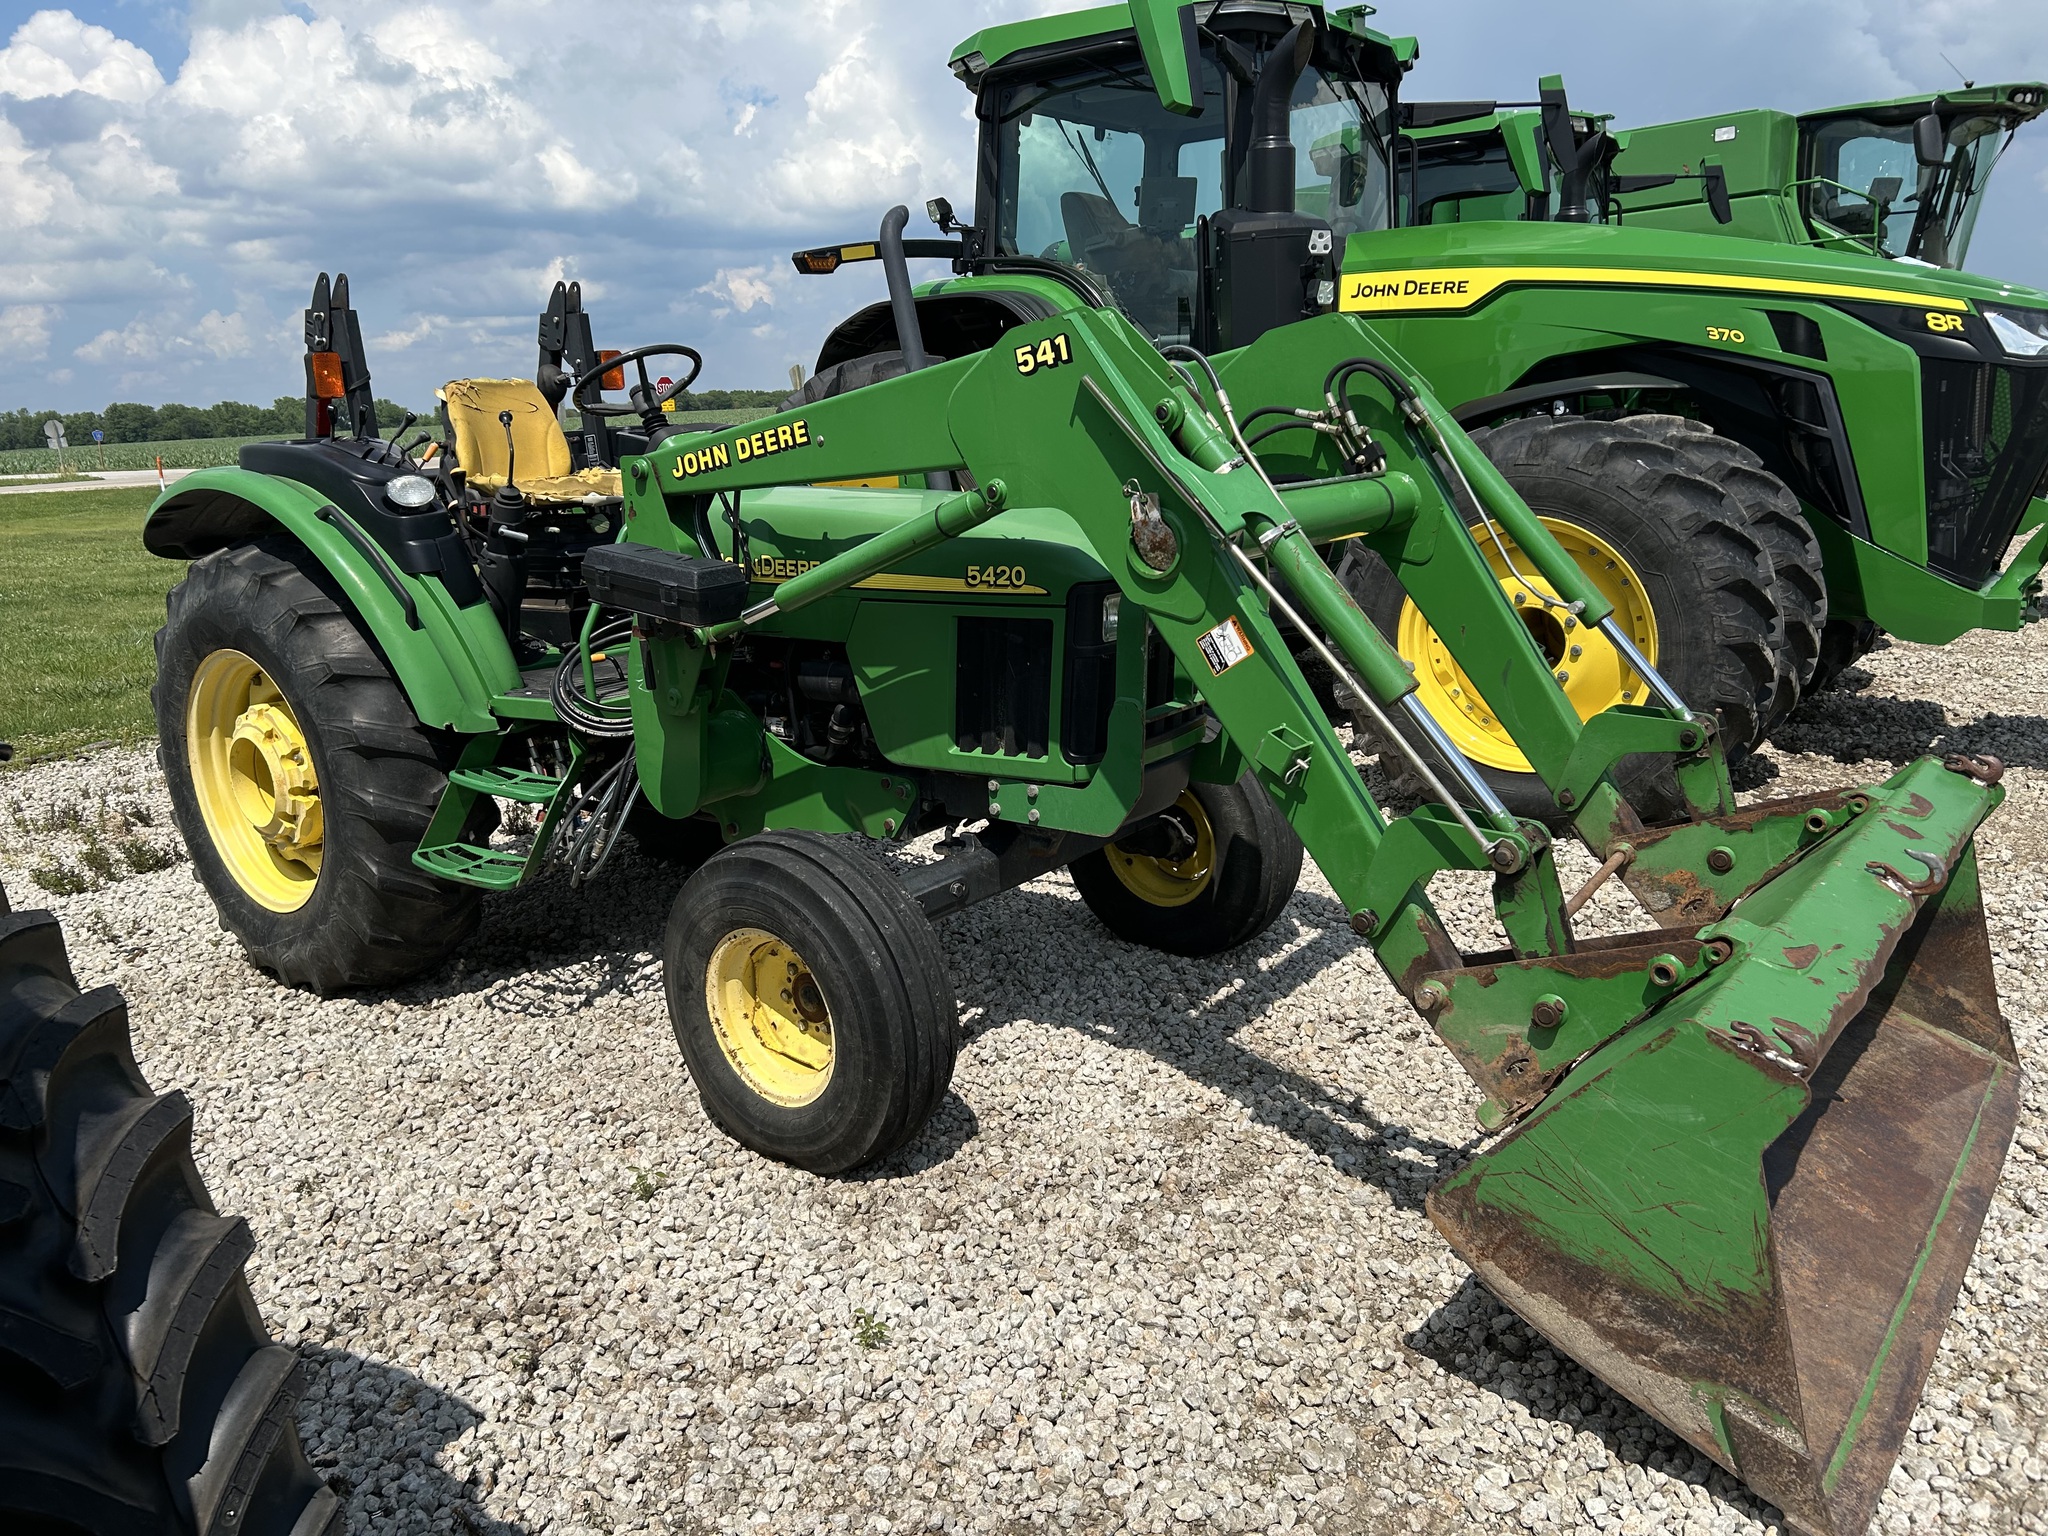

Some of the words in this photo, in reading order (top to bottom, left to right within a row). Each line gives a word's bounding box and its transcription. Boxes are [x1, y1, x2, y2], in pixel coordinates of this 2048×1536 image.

[1350, 282, 1400, 299] JOHN
[1403, 280, 1470, 296] DEERE
[1925, 312, 1965, 332] 8R
[1706, 326, 1745, 343] 370
[1015, 333, 1071, 375] 541
[657, 383, 674, 393] STO
[672, 443, 731, 480] JOHN
[735, 420, 810, 462] DEERE
[967, 565, 1026, 587] 5420
